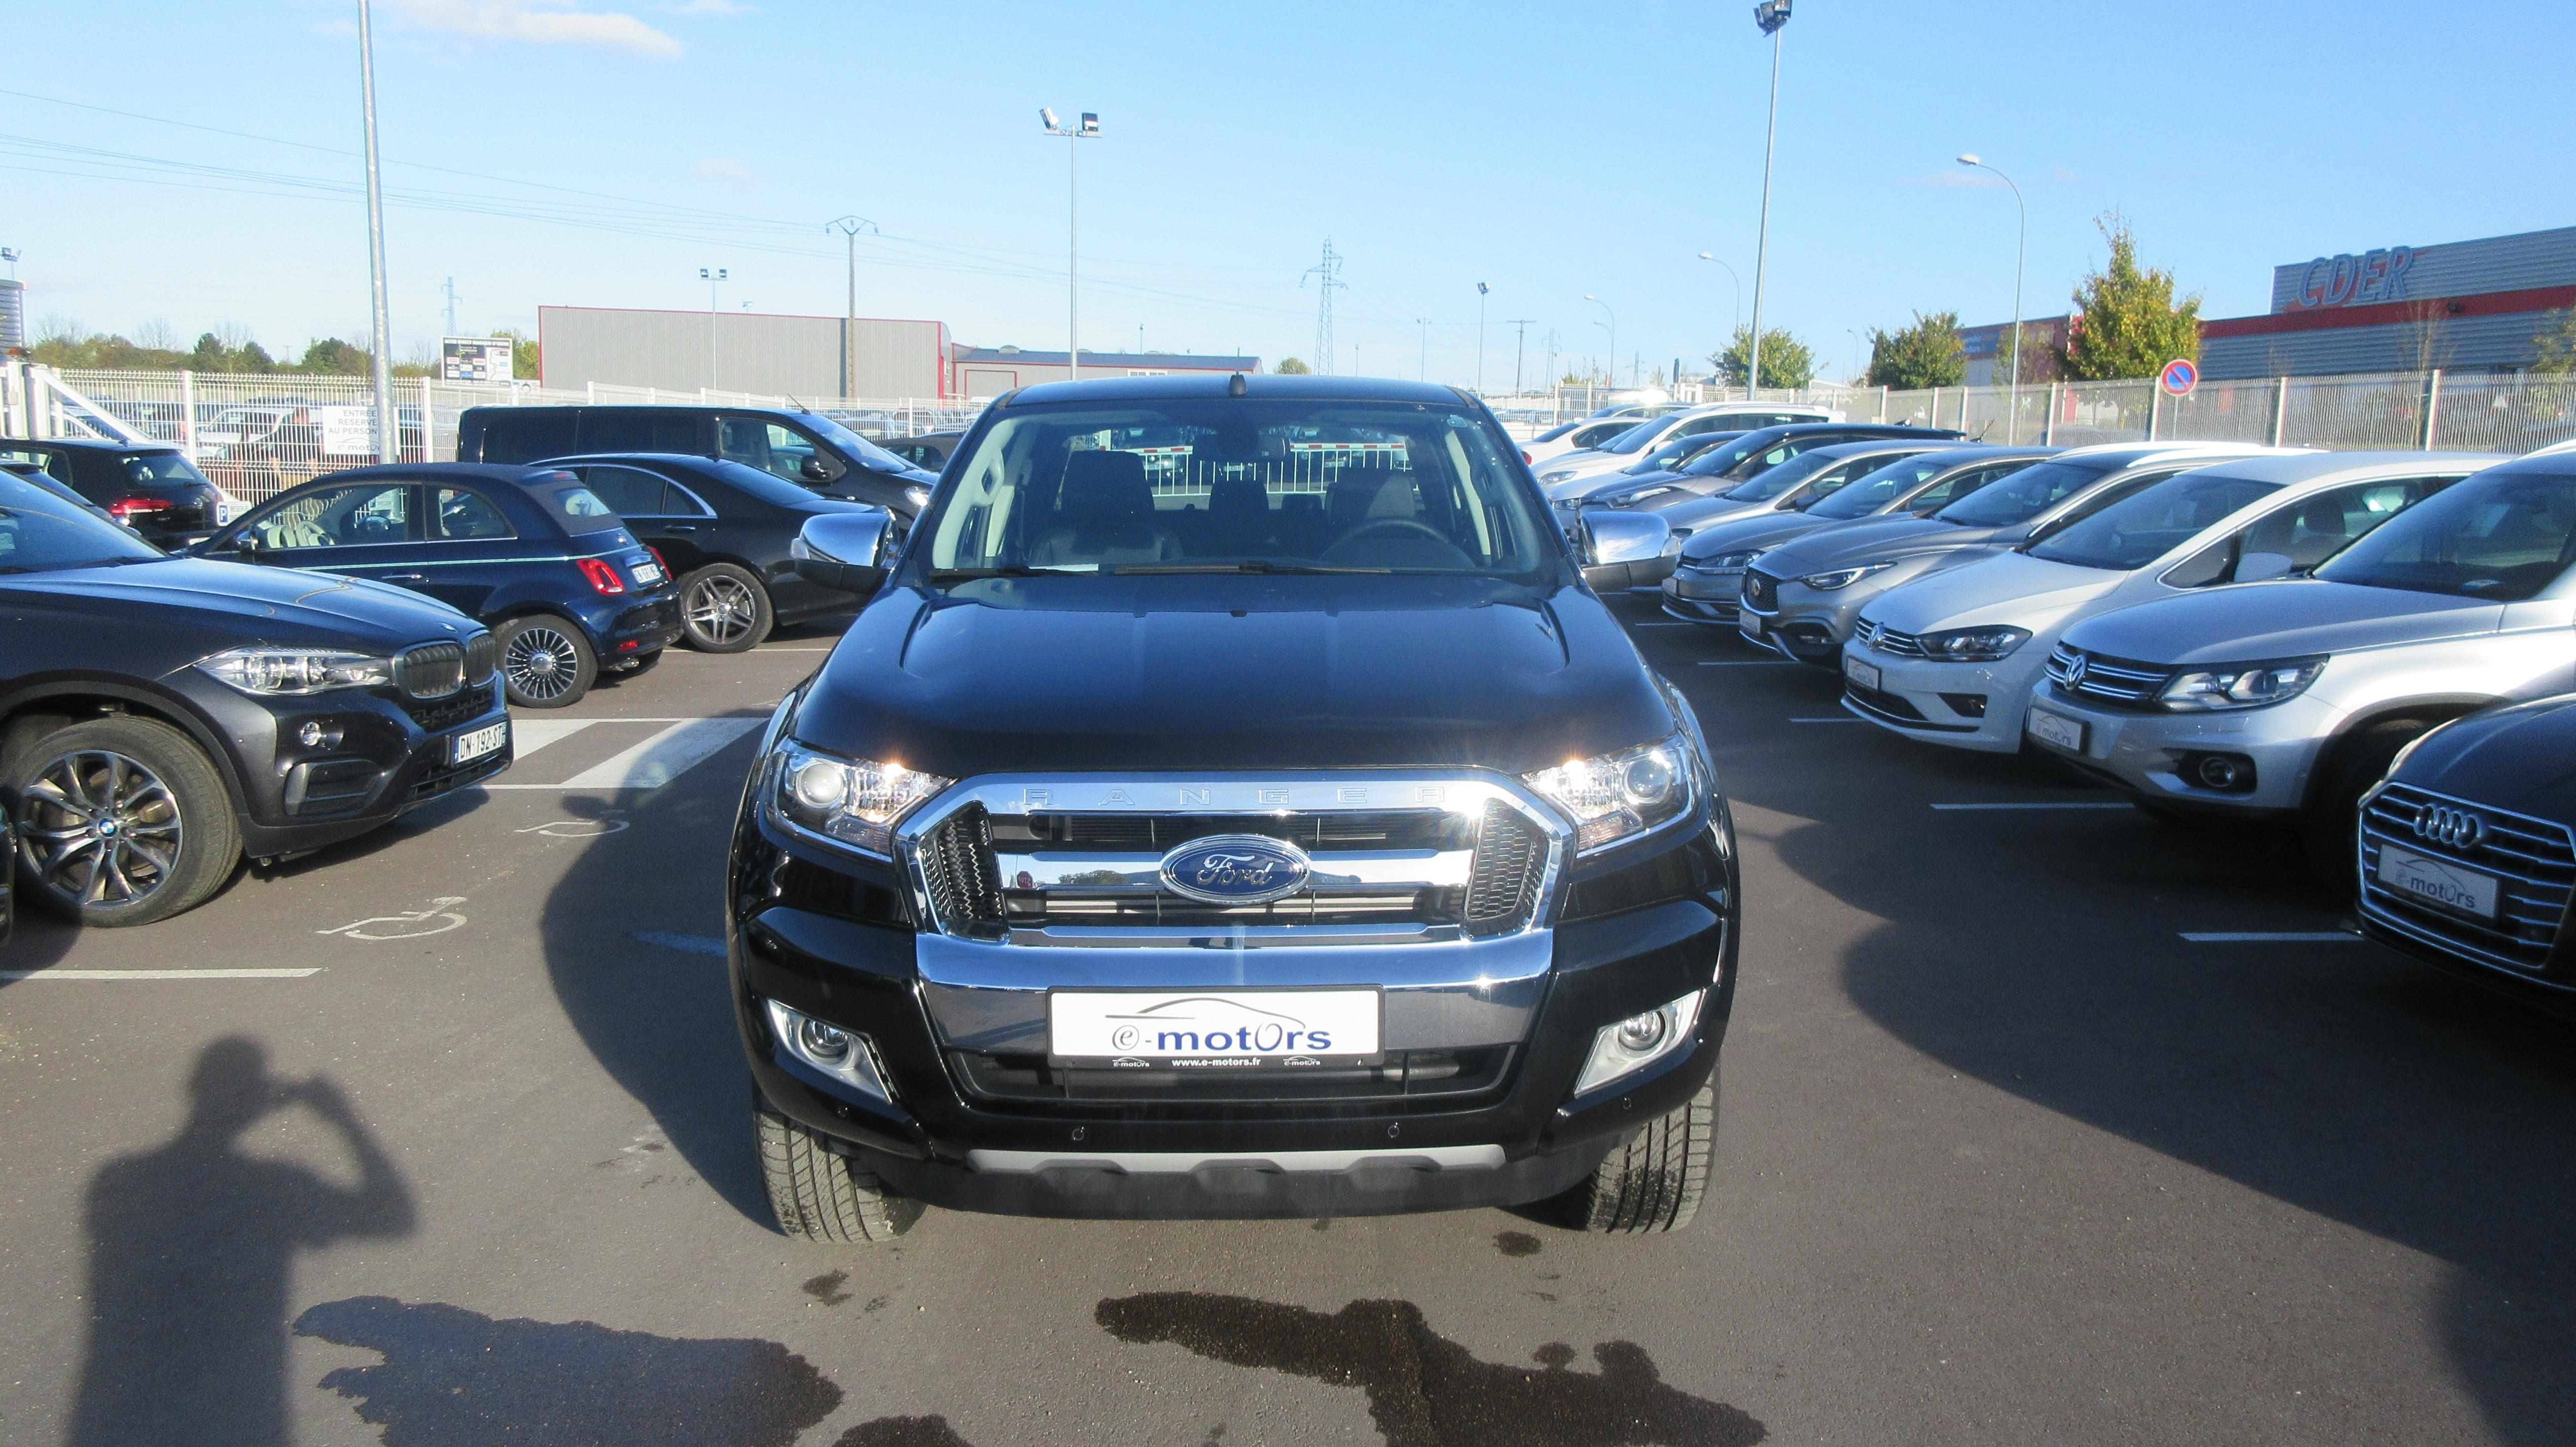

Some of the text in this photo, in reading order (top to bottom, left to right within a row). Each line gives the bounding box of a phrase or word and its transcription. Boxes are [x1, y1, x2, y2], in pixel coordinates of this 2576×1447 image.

[2299, 245, 2413, 307] CDER
[1022, 786, 1446, 806] RANGER
[1197, 854, 1274, 885] Ford
[1171, 1057, 1261, 1067] www.e-motors.fr
